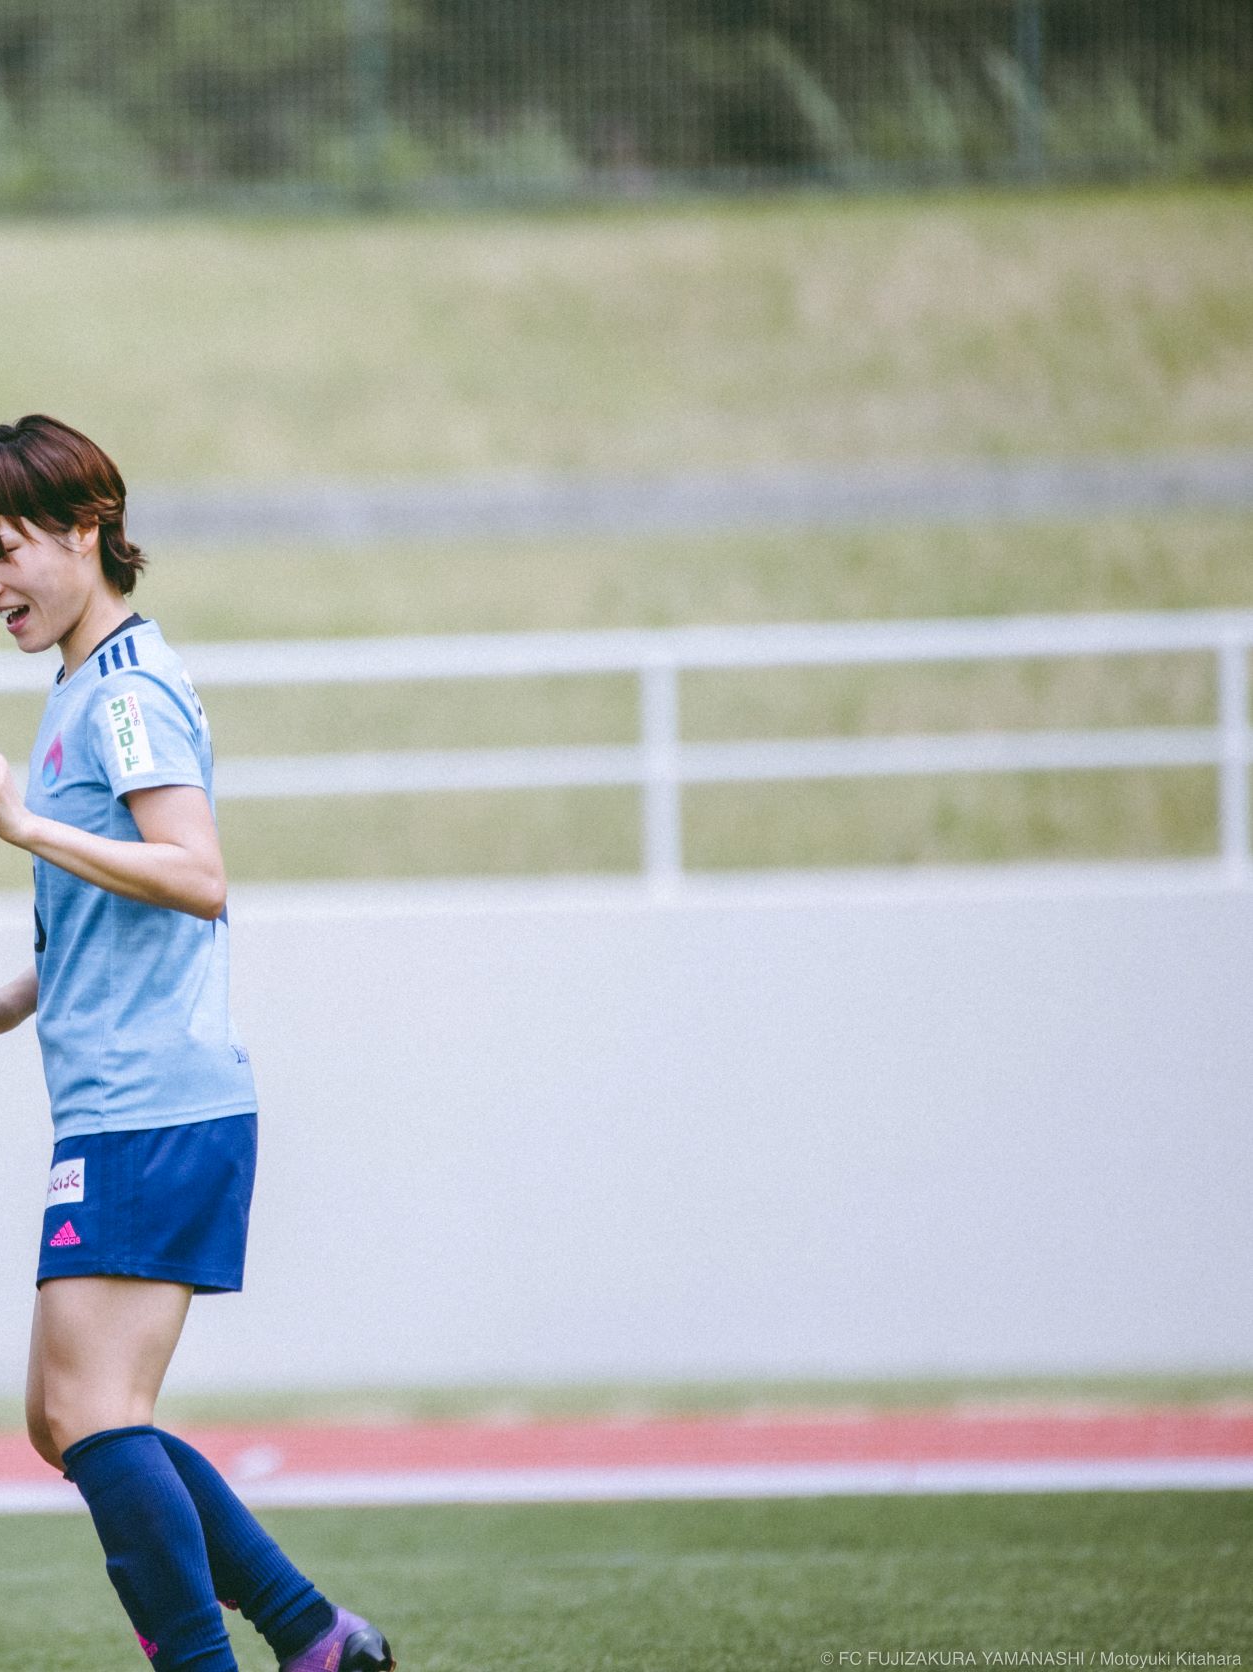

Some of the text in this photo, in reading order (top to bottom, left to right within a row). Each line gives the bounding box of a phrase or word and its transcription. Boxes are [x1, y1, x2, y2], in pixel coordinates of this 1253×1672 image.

[111, 698, 140, 772] サンロード
[49, 1235, 81, 1247] adidas
